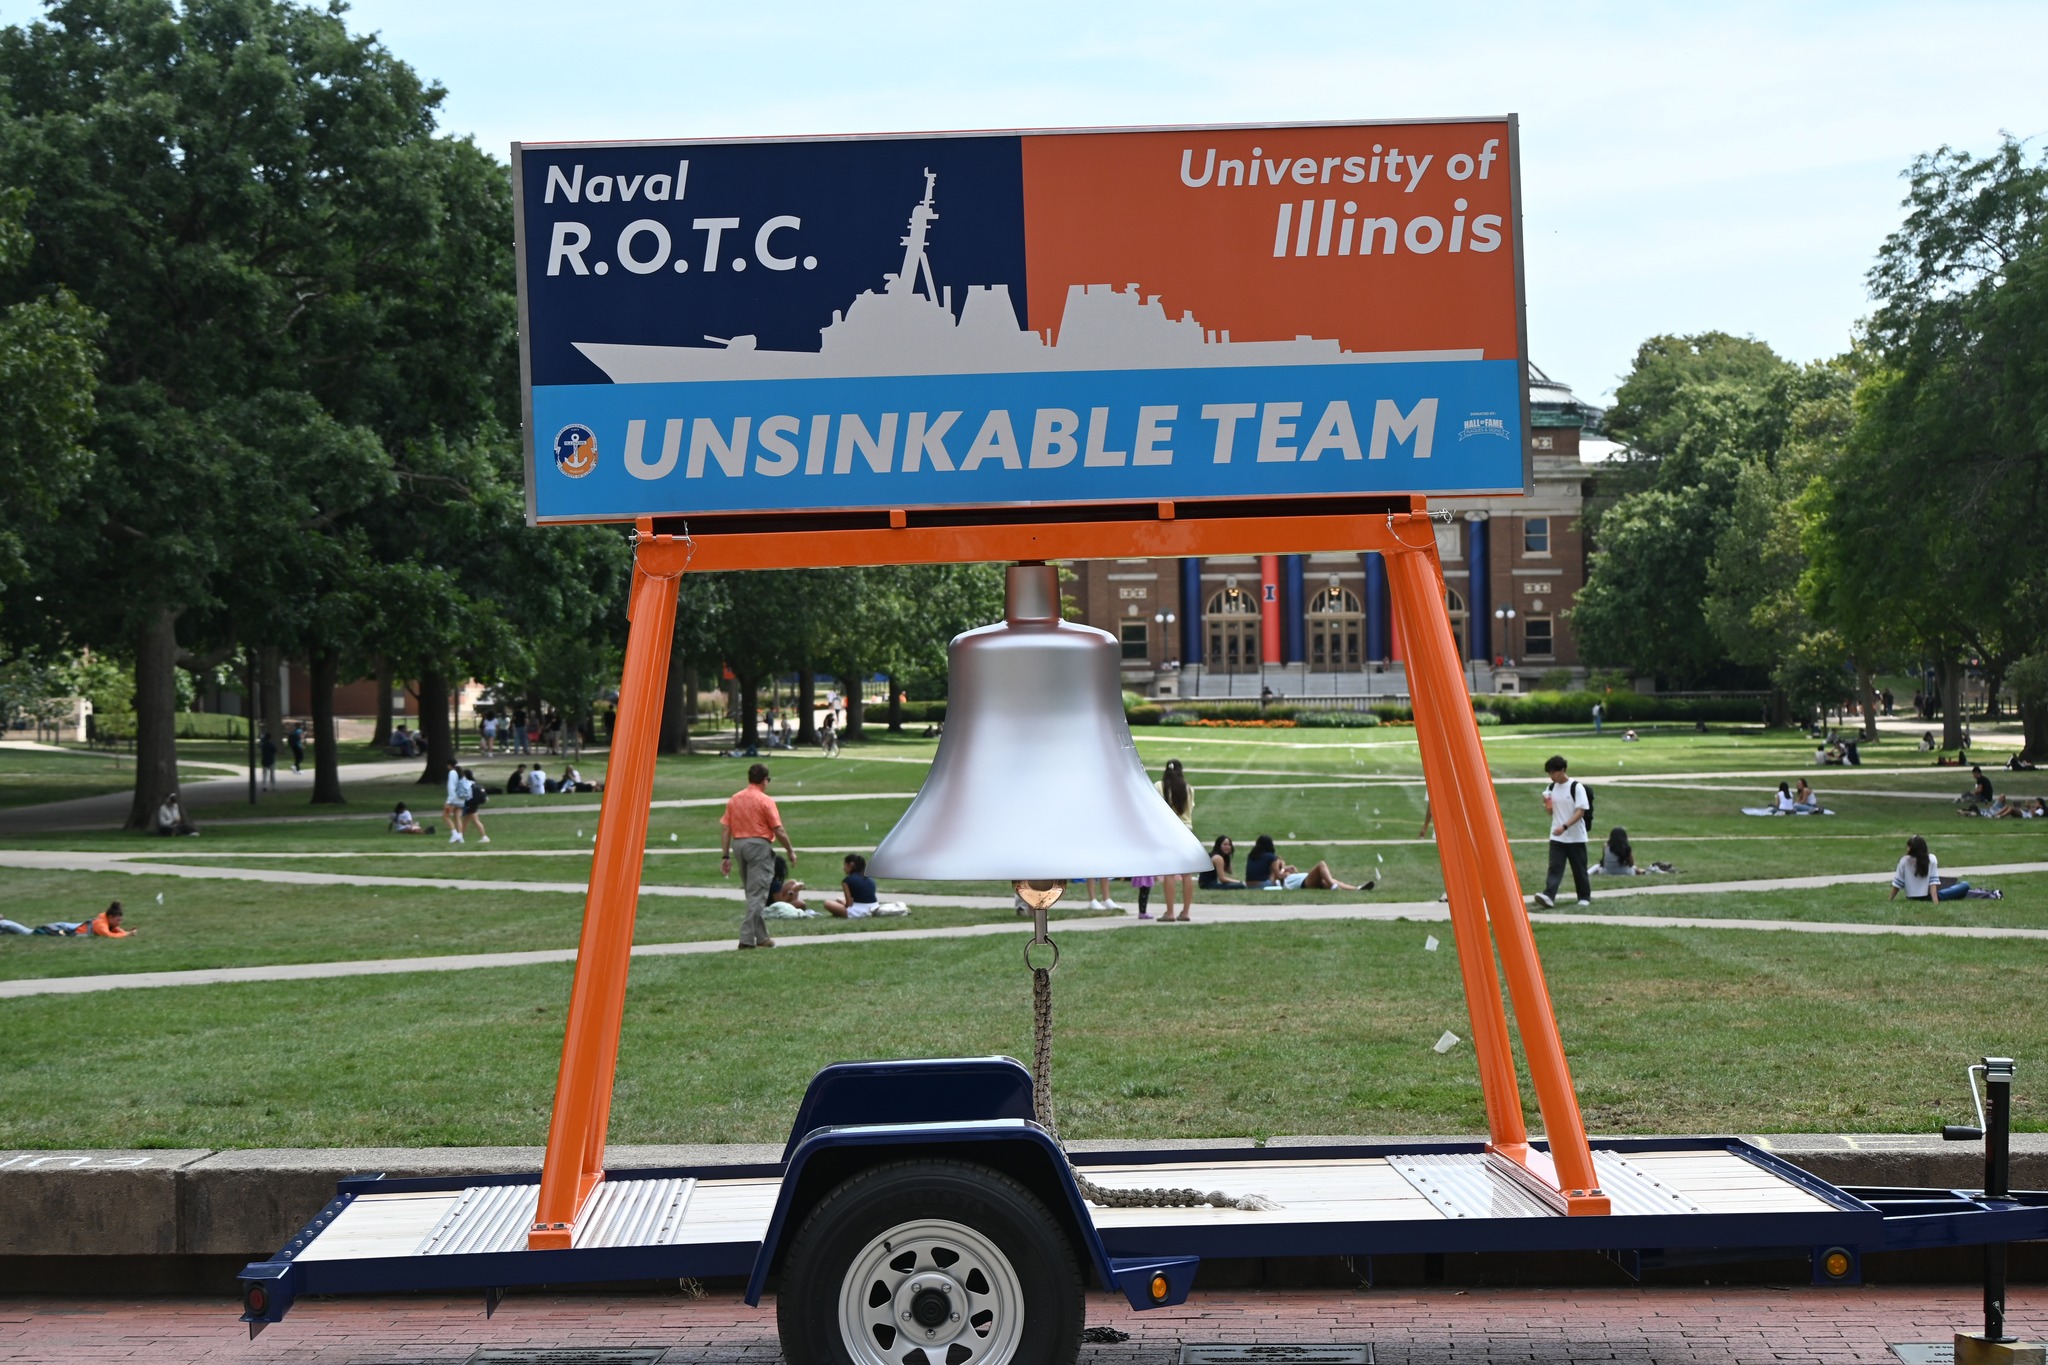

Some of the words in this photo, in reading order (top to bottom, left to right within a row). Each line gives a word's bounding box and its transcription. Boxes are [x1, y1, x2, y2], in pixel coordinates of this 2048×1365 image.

[544, 160, 689, 203] Naval
[1180, 143, 1433, 193] University
[1446, 139, 1500, 181] of
[546, 215, 818, 276] R.O.T.C.
[1273, 198, 1503, 258] Illinois
[624, 405, 1179, 481] UNSINKABLE
[1201, 398, 1439, 464] TEAM
[1464, 419, 1480, 428] HALL
[1485, 418, 1503, 428] FAME
[1264, 584, 1276, 602] I
